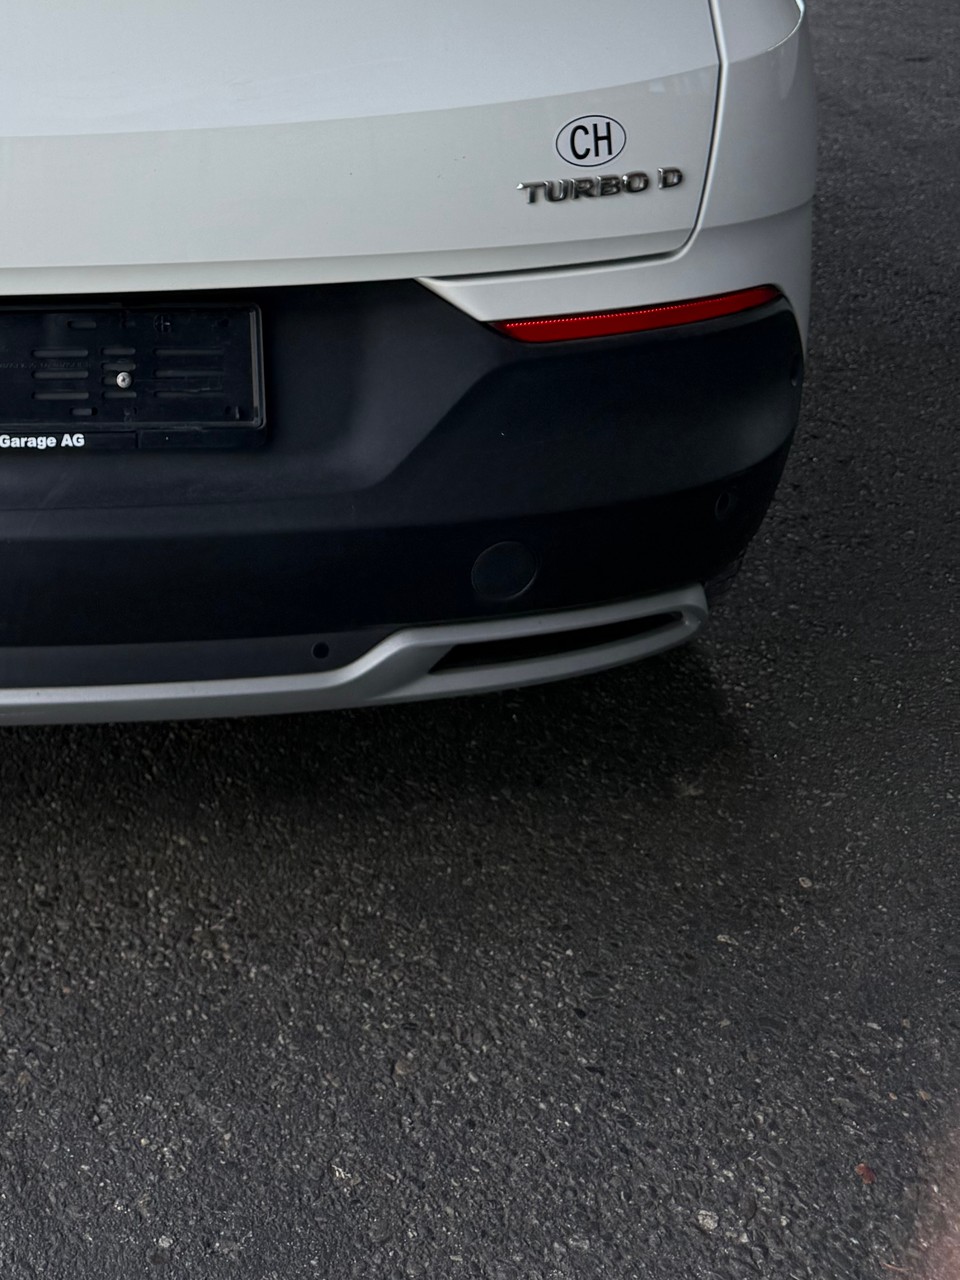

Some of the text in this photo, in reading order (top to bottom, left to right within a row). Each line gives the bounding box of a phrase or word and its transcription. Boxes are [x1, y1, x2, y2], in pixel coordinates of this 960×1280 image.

[570, 121, 613, 160] CH
[516, 167, 684, 204] TURBO D
[60, 433, 85, 448] AG
